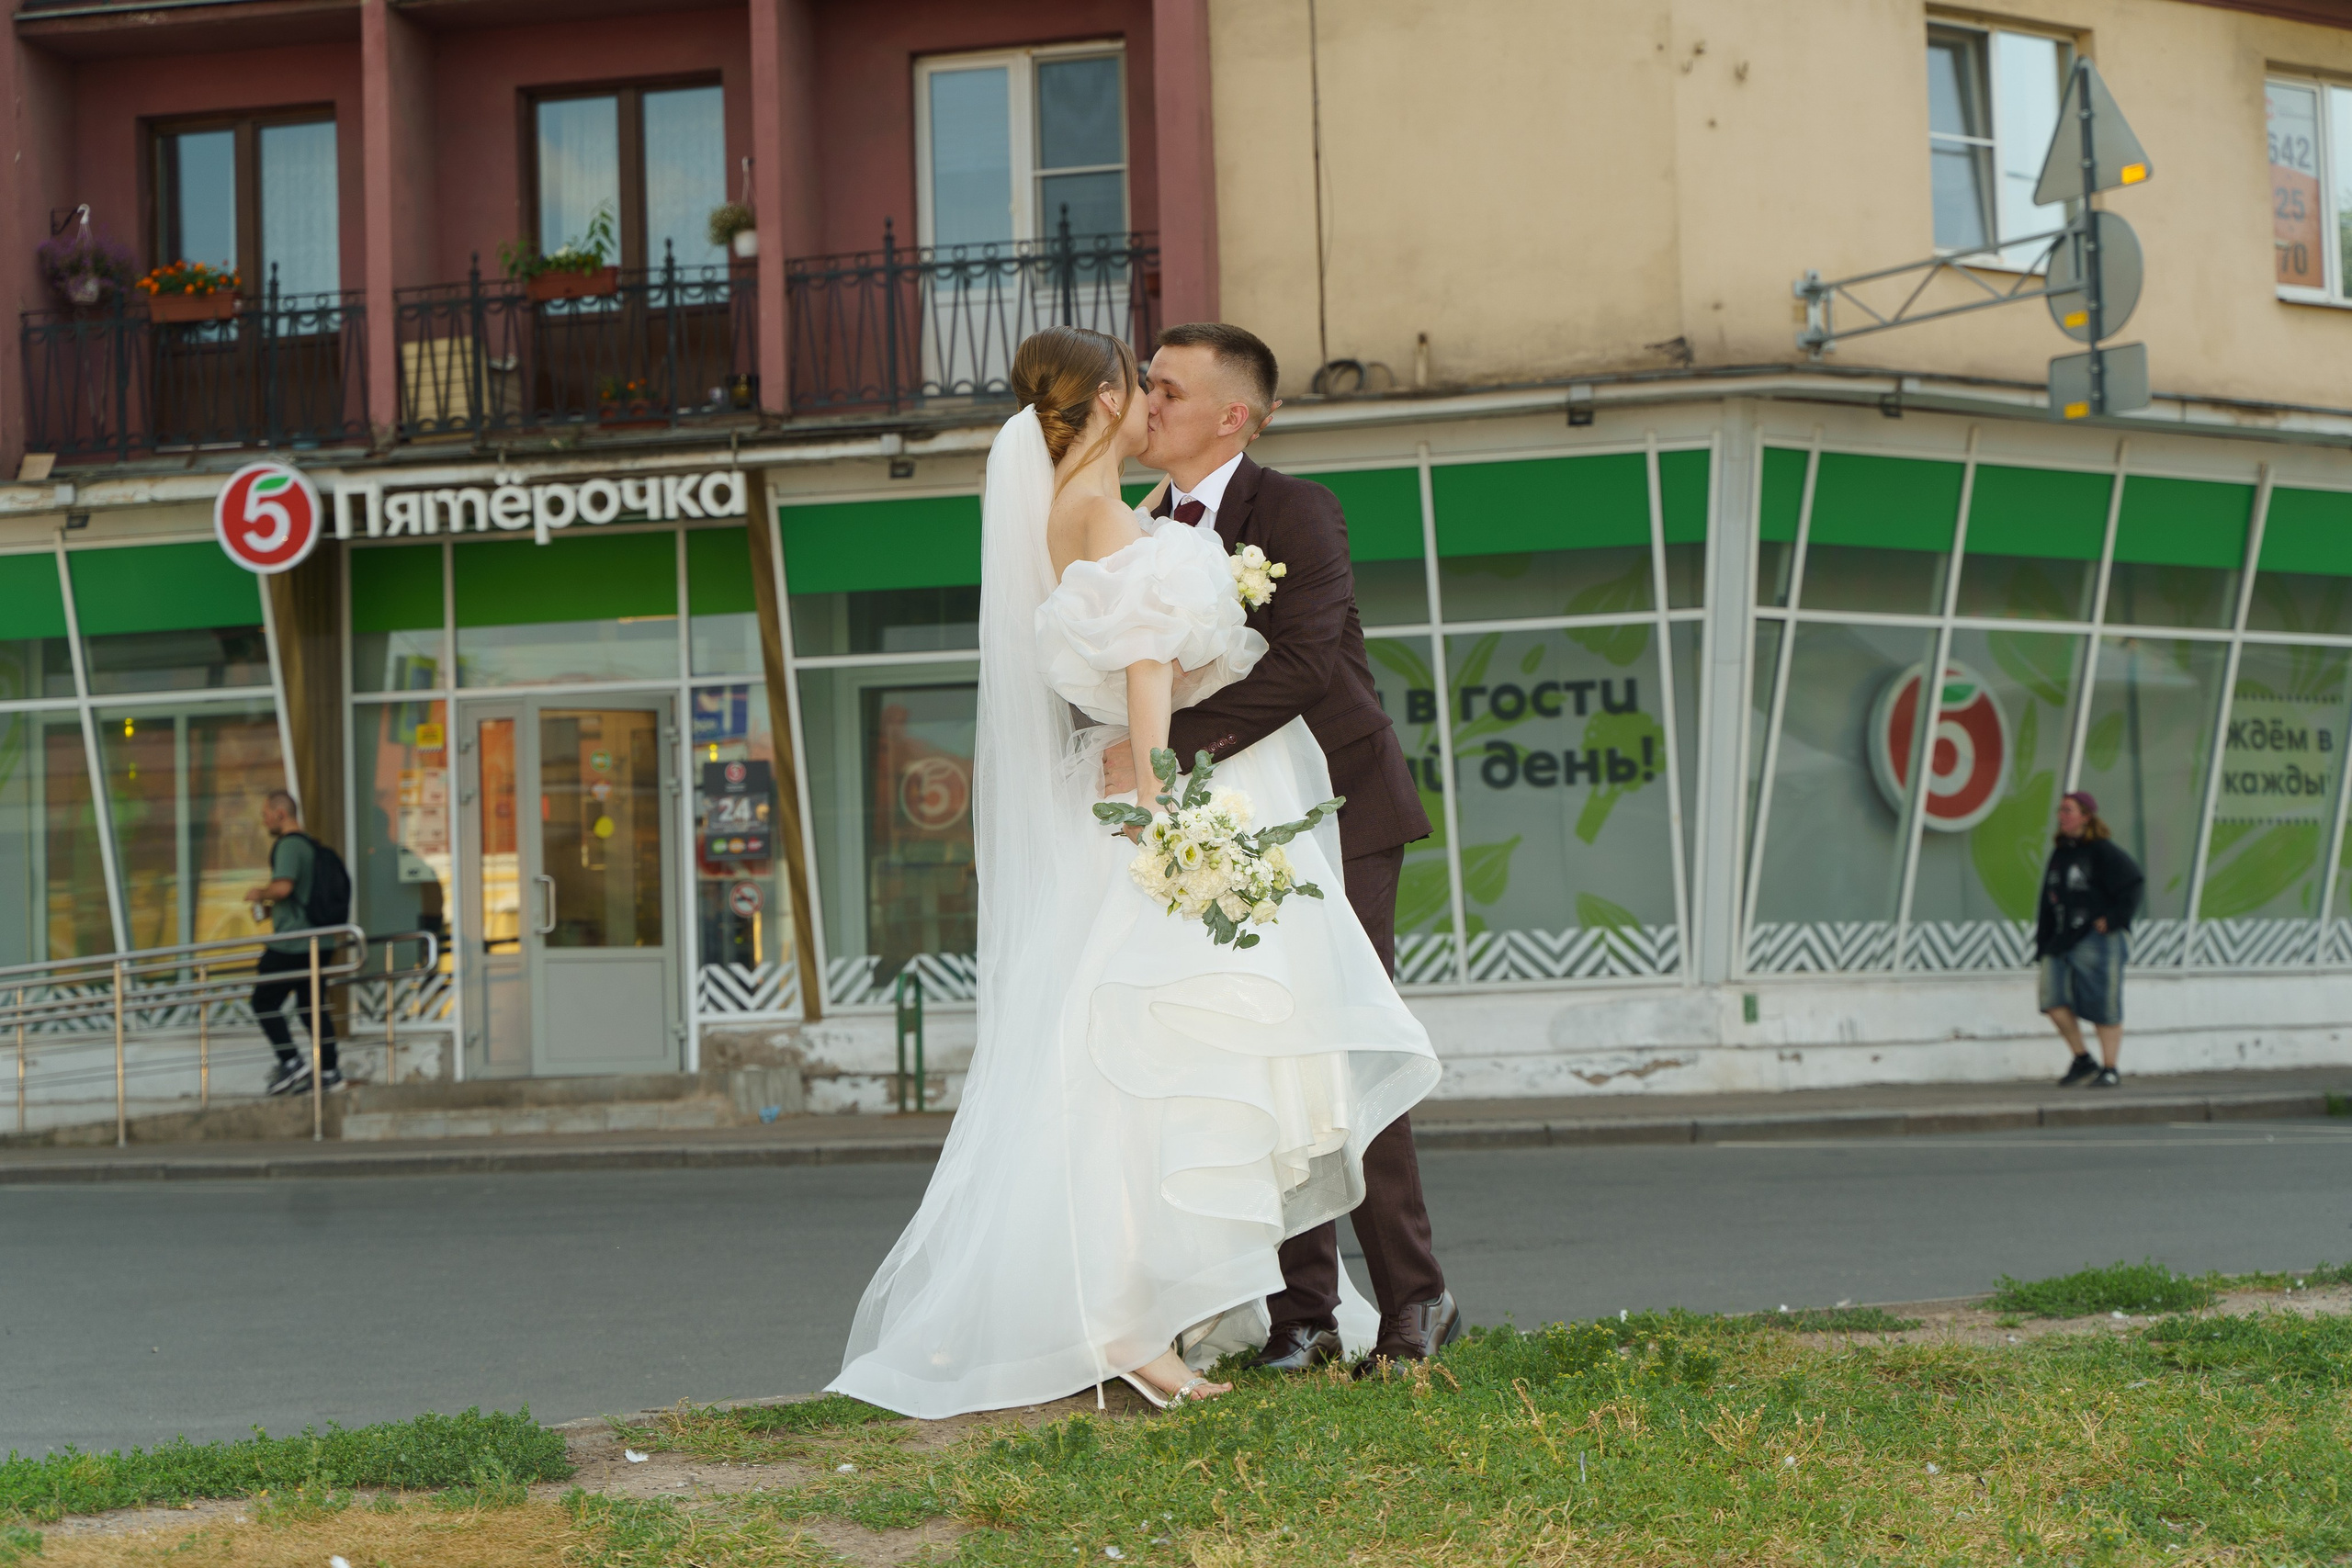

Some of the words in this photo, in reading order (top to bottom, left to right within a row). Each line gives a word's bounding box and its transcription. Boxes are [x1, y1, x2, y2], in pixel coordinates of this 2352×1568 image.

[2275, 186, 2306, 222] 25
[243, 472, 292, 552] 5
[334, 471, 747, 545] Пятёрочка
[1407, 689, 1439, 724] в
[1460, 678, 1638, 723] гости
[2319, 728, 2334, 752] в
[1480, 736, 1656, 791] день!
[2224, 764, 2331, 795] кажды
[718, 796, 753, 823] 24
